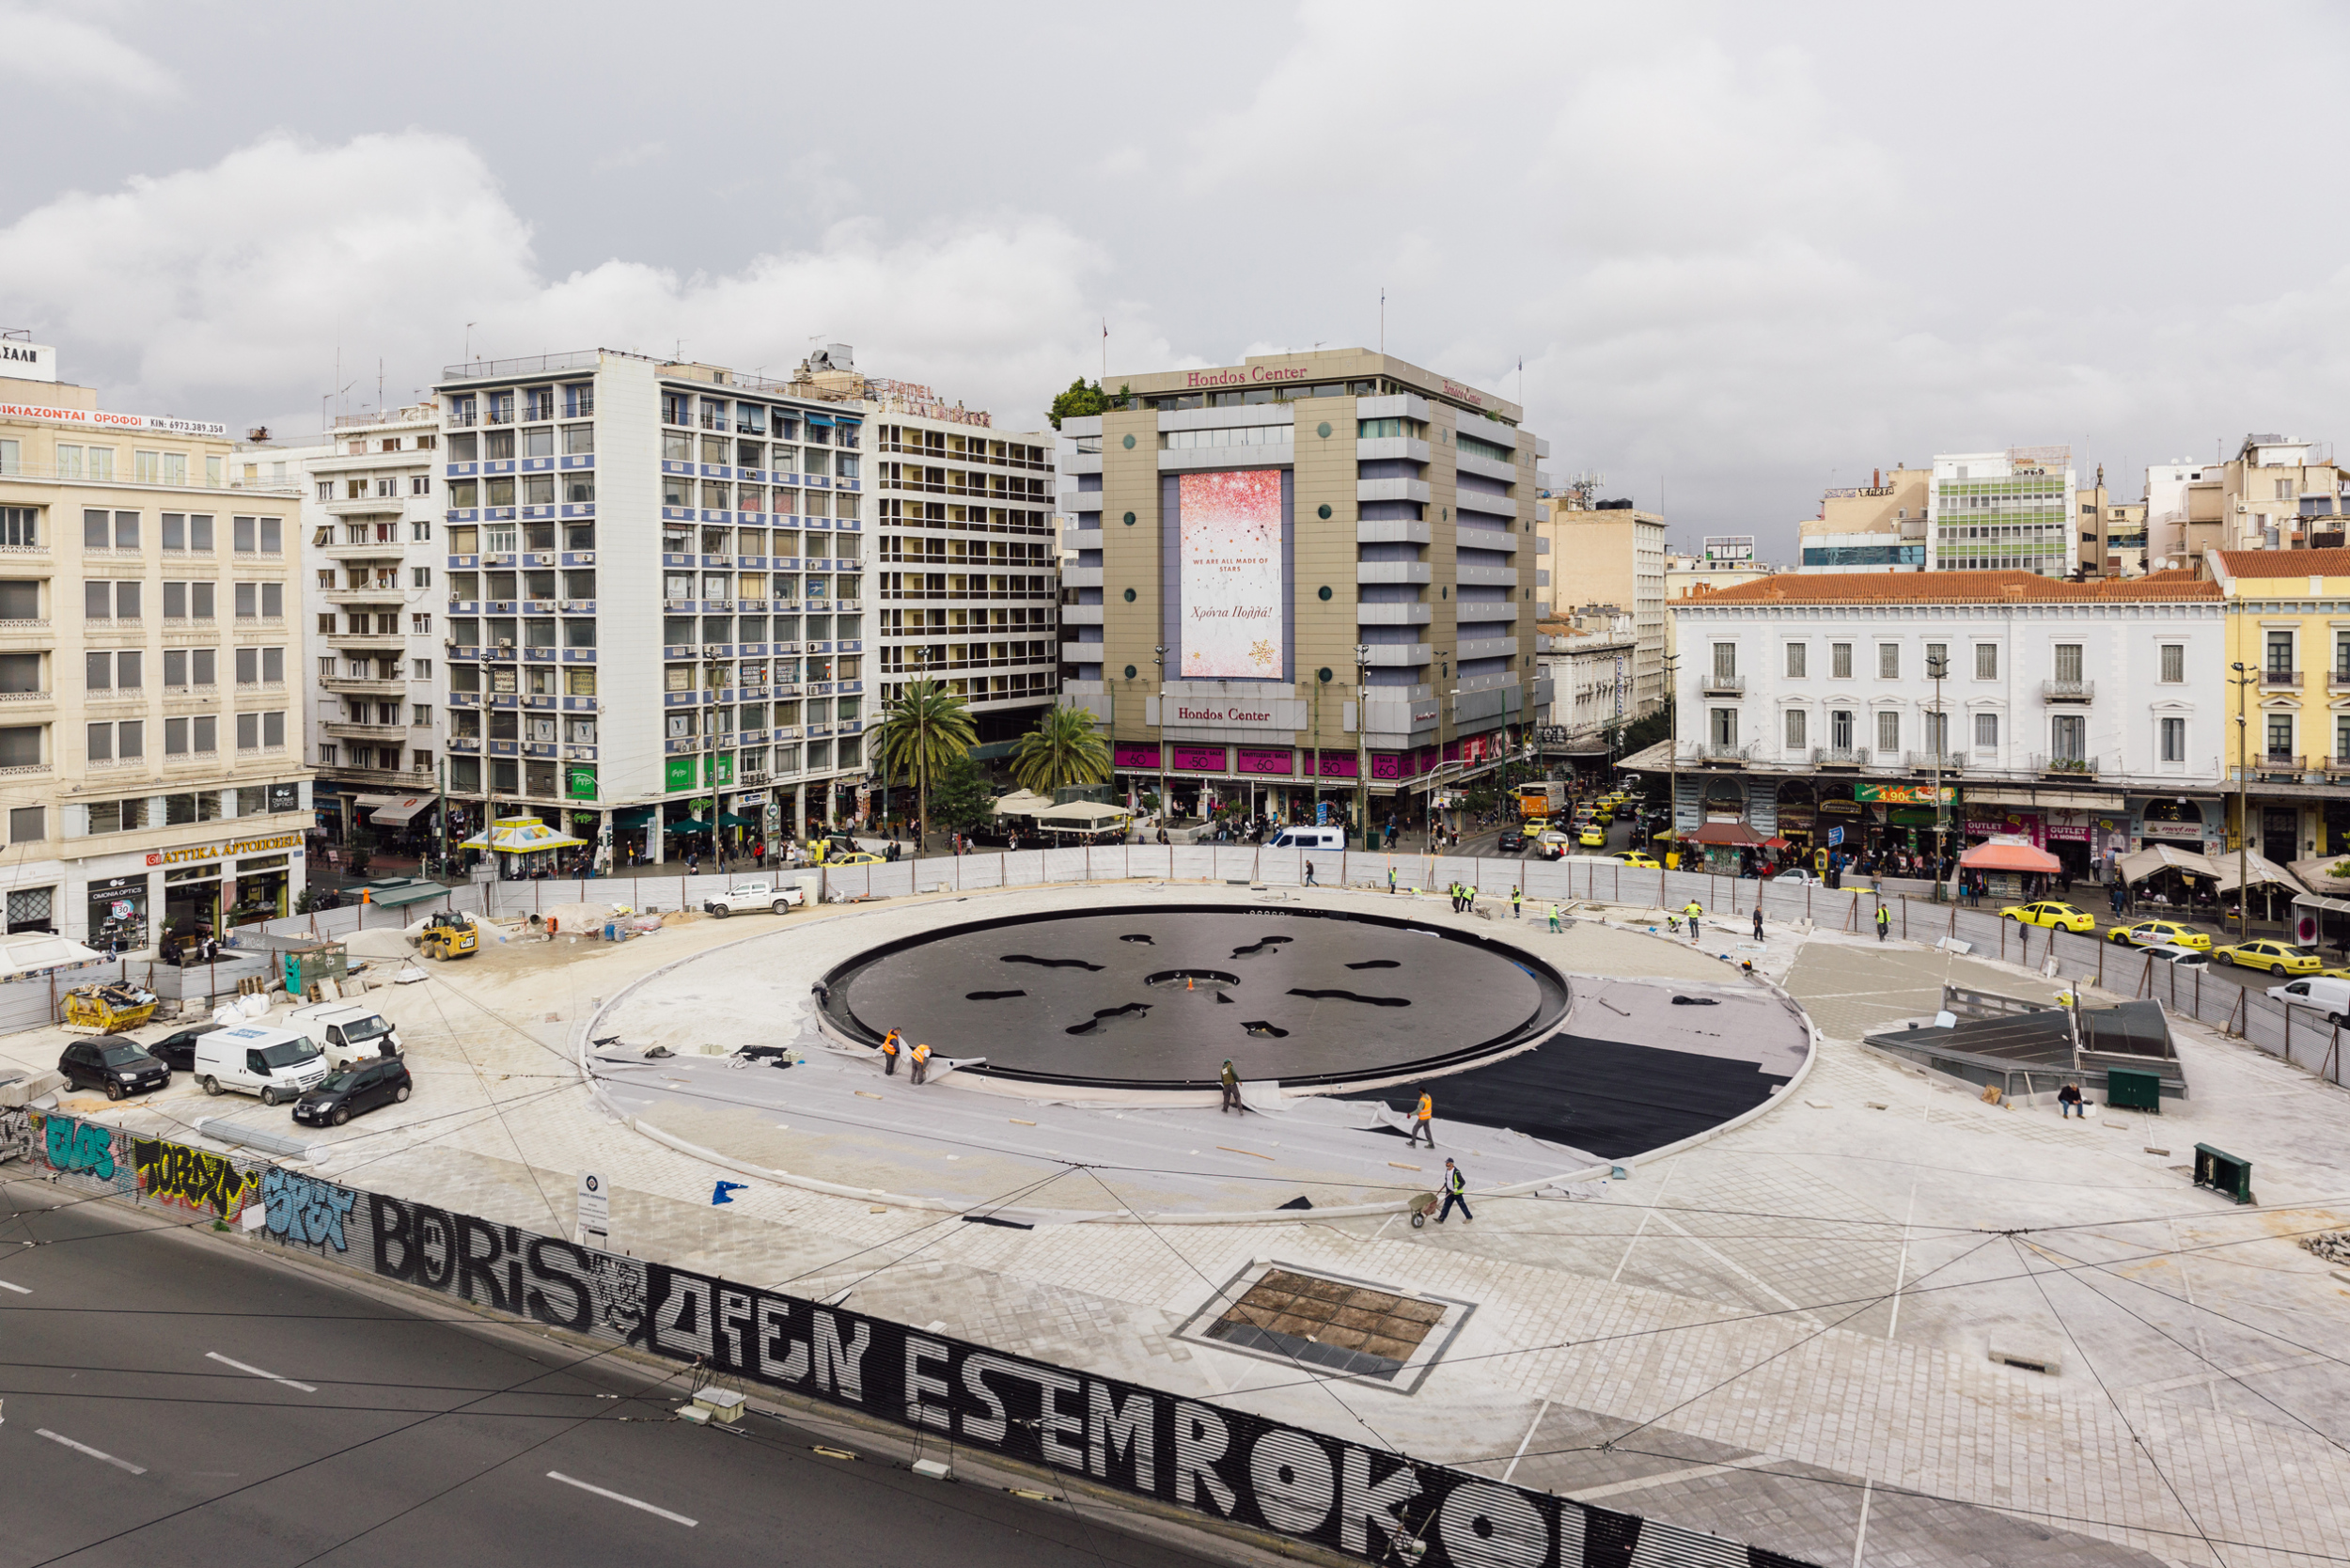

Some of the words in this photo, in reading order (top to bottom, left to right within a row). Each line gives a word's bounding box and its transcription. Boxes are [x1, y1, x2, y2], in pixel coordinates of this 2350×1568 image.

[0, 347, 37, 363] ΣΑΛΗ
[1187, 371, 1246, 387] Hondos
[1252, 365, 1308, 383] Center
[888, 379, 934, 400] HOTEL
[94, 413, 142, 426] ΟΡΟΦΟΙ
[150, 418, 167, 429] ΚΙΝ:
[169, 420, 224, 433] 6973.389.358
[1190, 605, 1229, 621] Χρόνια
[1231, 605, 1273, 619] Πολλά!
[1179, 707, 1223, 720] Hondos
[1228, 707, 1271, 721] Center
[1879, 792, 1911, 802] 4,90€
[1968, 822, 2002, 830] OUTLET
[2050, 826, 2087, 835] OUTLET
[163, 846, 219, 864] ΑΤΤΙΚΑ
[222, 835, 304, 856] ΑΡΤΟΠΟΙΕΙΑ
[93, 891, 118, 900] OMONIA
[119, 887, 142, 896] OPTICS
